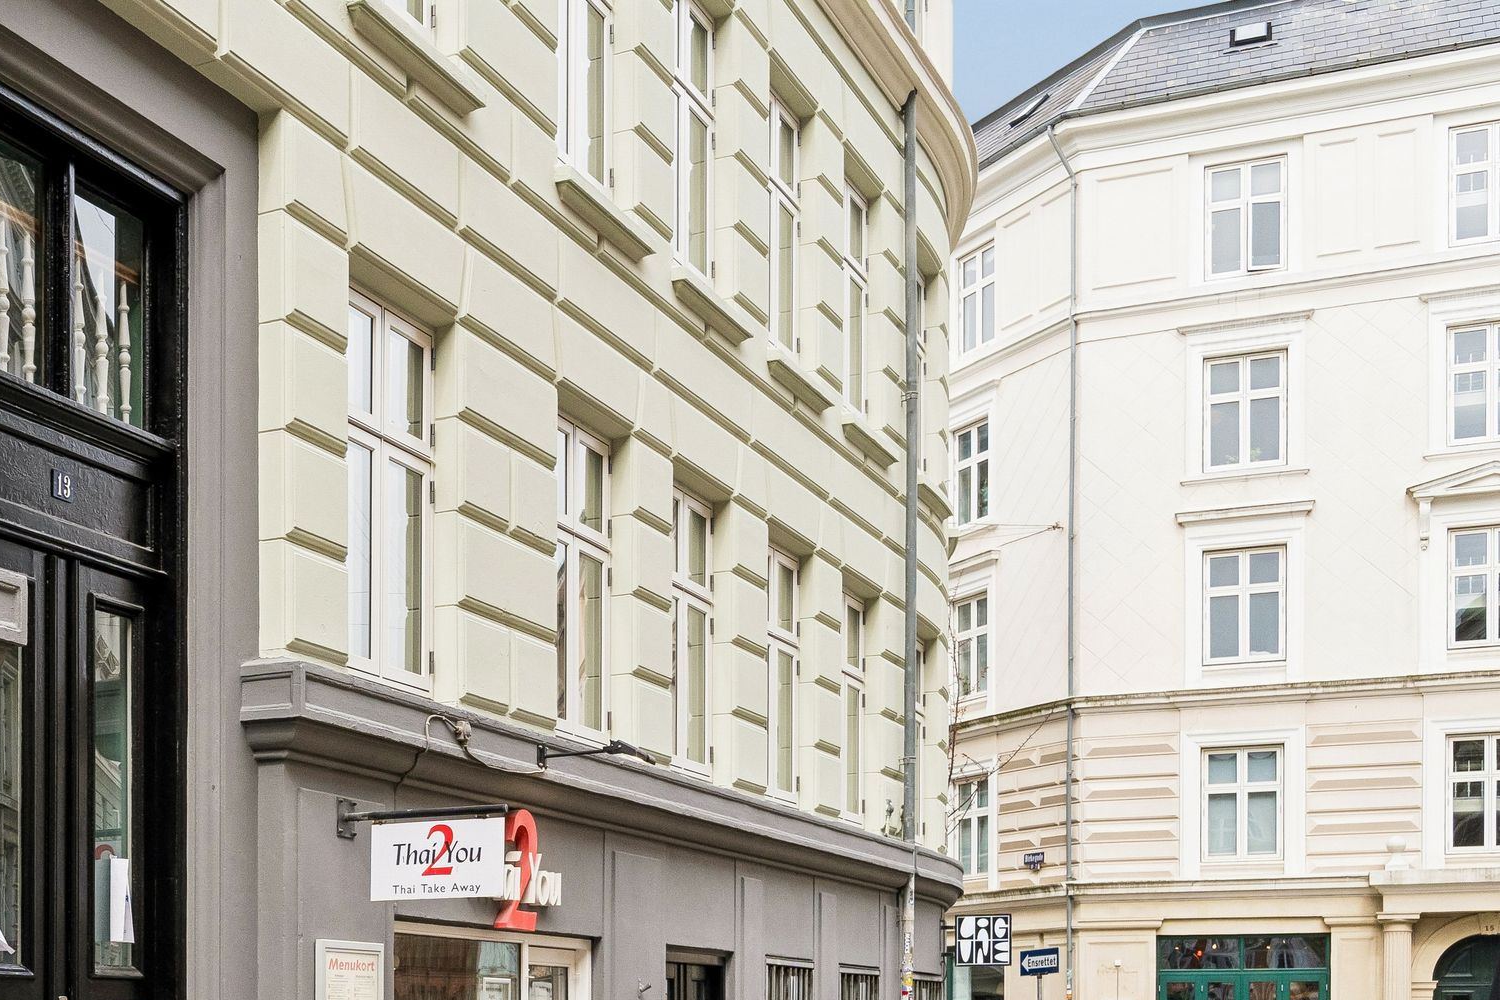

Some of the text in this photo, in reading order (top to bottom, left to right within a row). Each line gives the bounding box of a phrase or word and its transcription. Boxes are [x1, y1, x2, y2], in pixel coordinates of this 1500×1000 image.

[57, 472, 71, 499] 13
[392, 882, 481, 895] Thai Take Away
[328, 958, 375, 972] Menukort
[1027, 955, 1057, 968] Ensrettet
